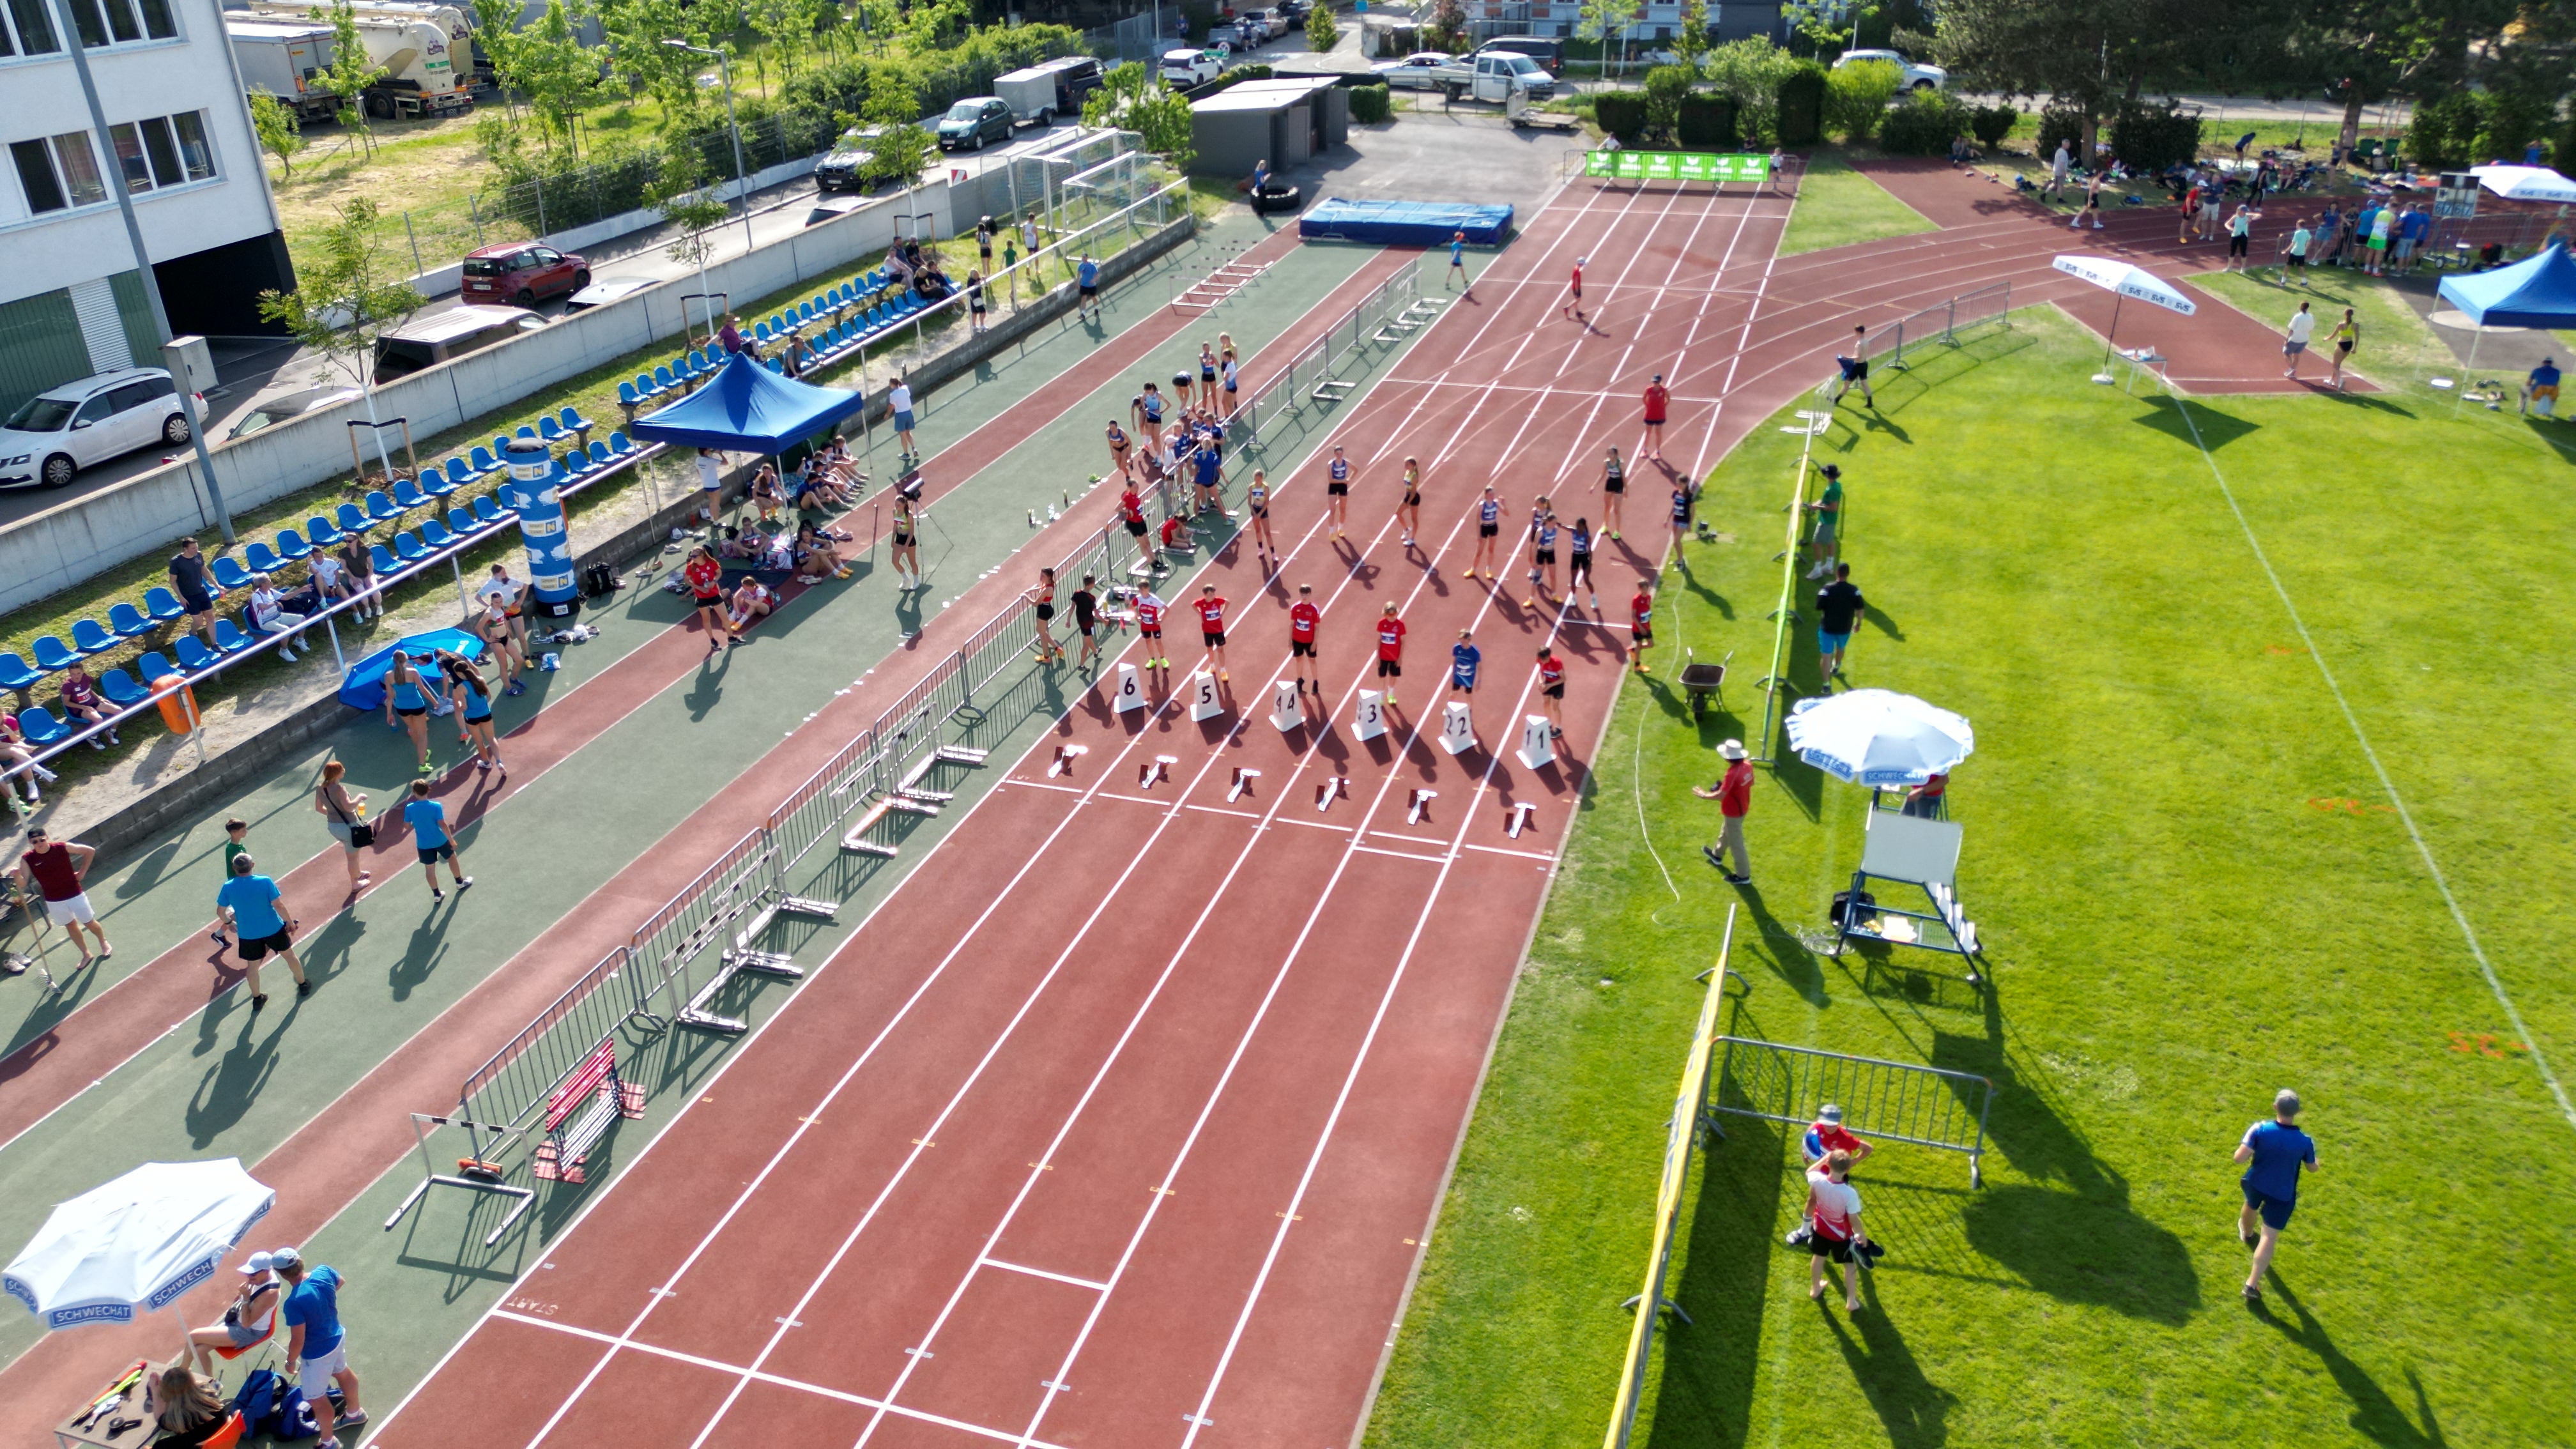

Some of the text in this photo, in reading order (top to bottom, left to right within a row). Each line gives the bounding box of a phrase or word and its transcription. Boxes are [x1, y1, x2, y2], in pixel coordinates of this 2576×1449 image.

[1124, 677, 1135, 696] 6
[1202, 685, 1211, 704] 5
[1287, 693, 1295, 712] 4
[1367, 704, 1376, 723] 3
[1446, 714, 1453, 735] 2
[1457, 716, 1467, 737] 2
[1526, 729, 1531, 747] 1
[1538, 729, 1544, 749] 1
[55, 1305, 130, 1322] SCHWECHAT
[507, 1296, 559, 1315] START
